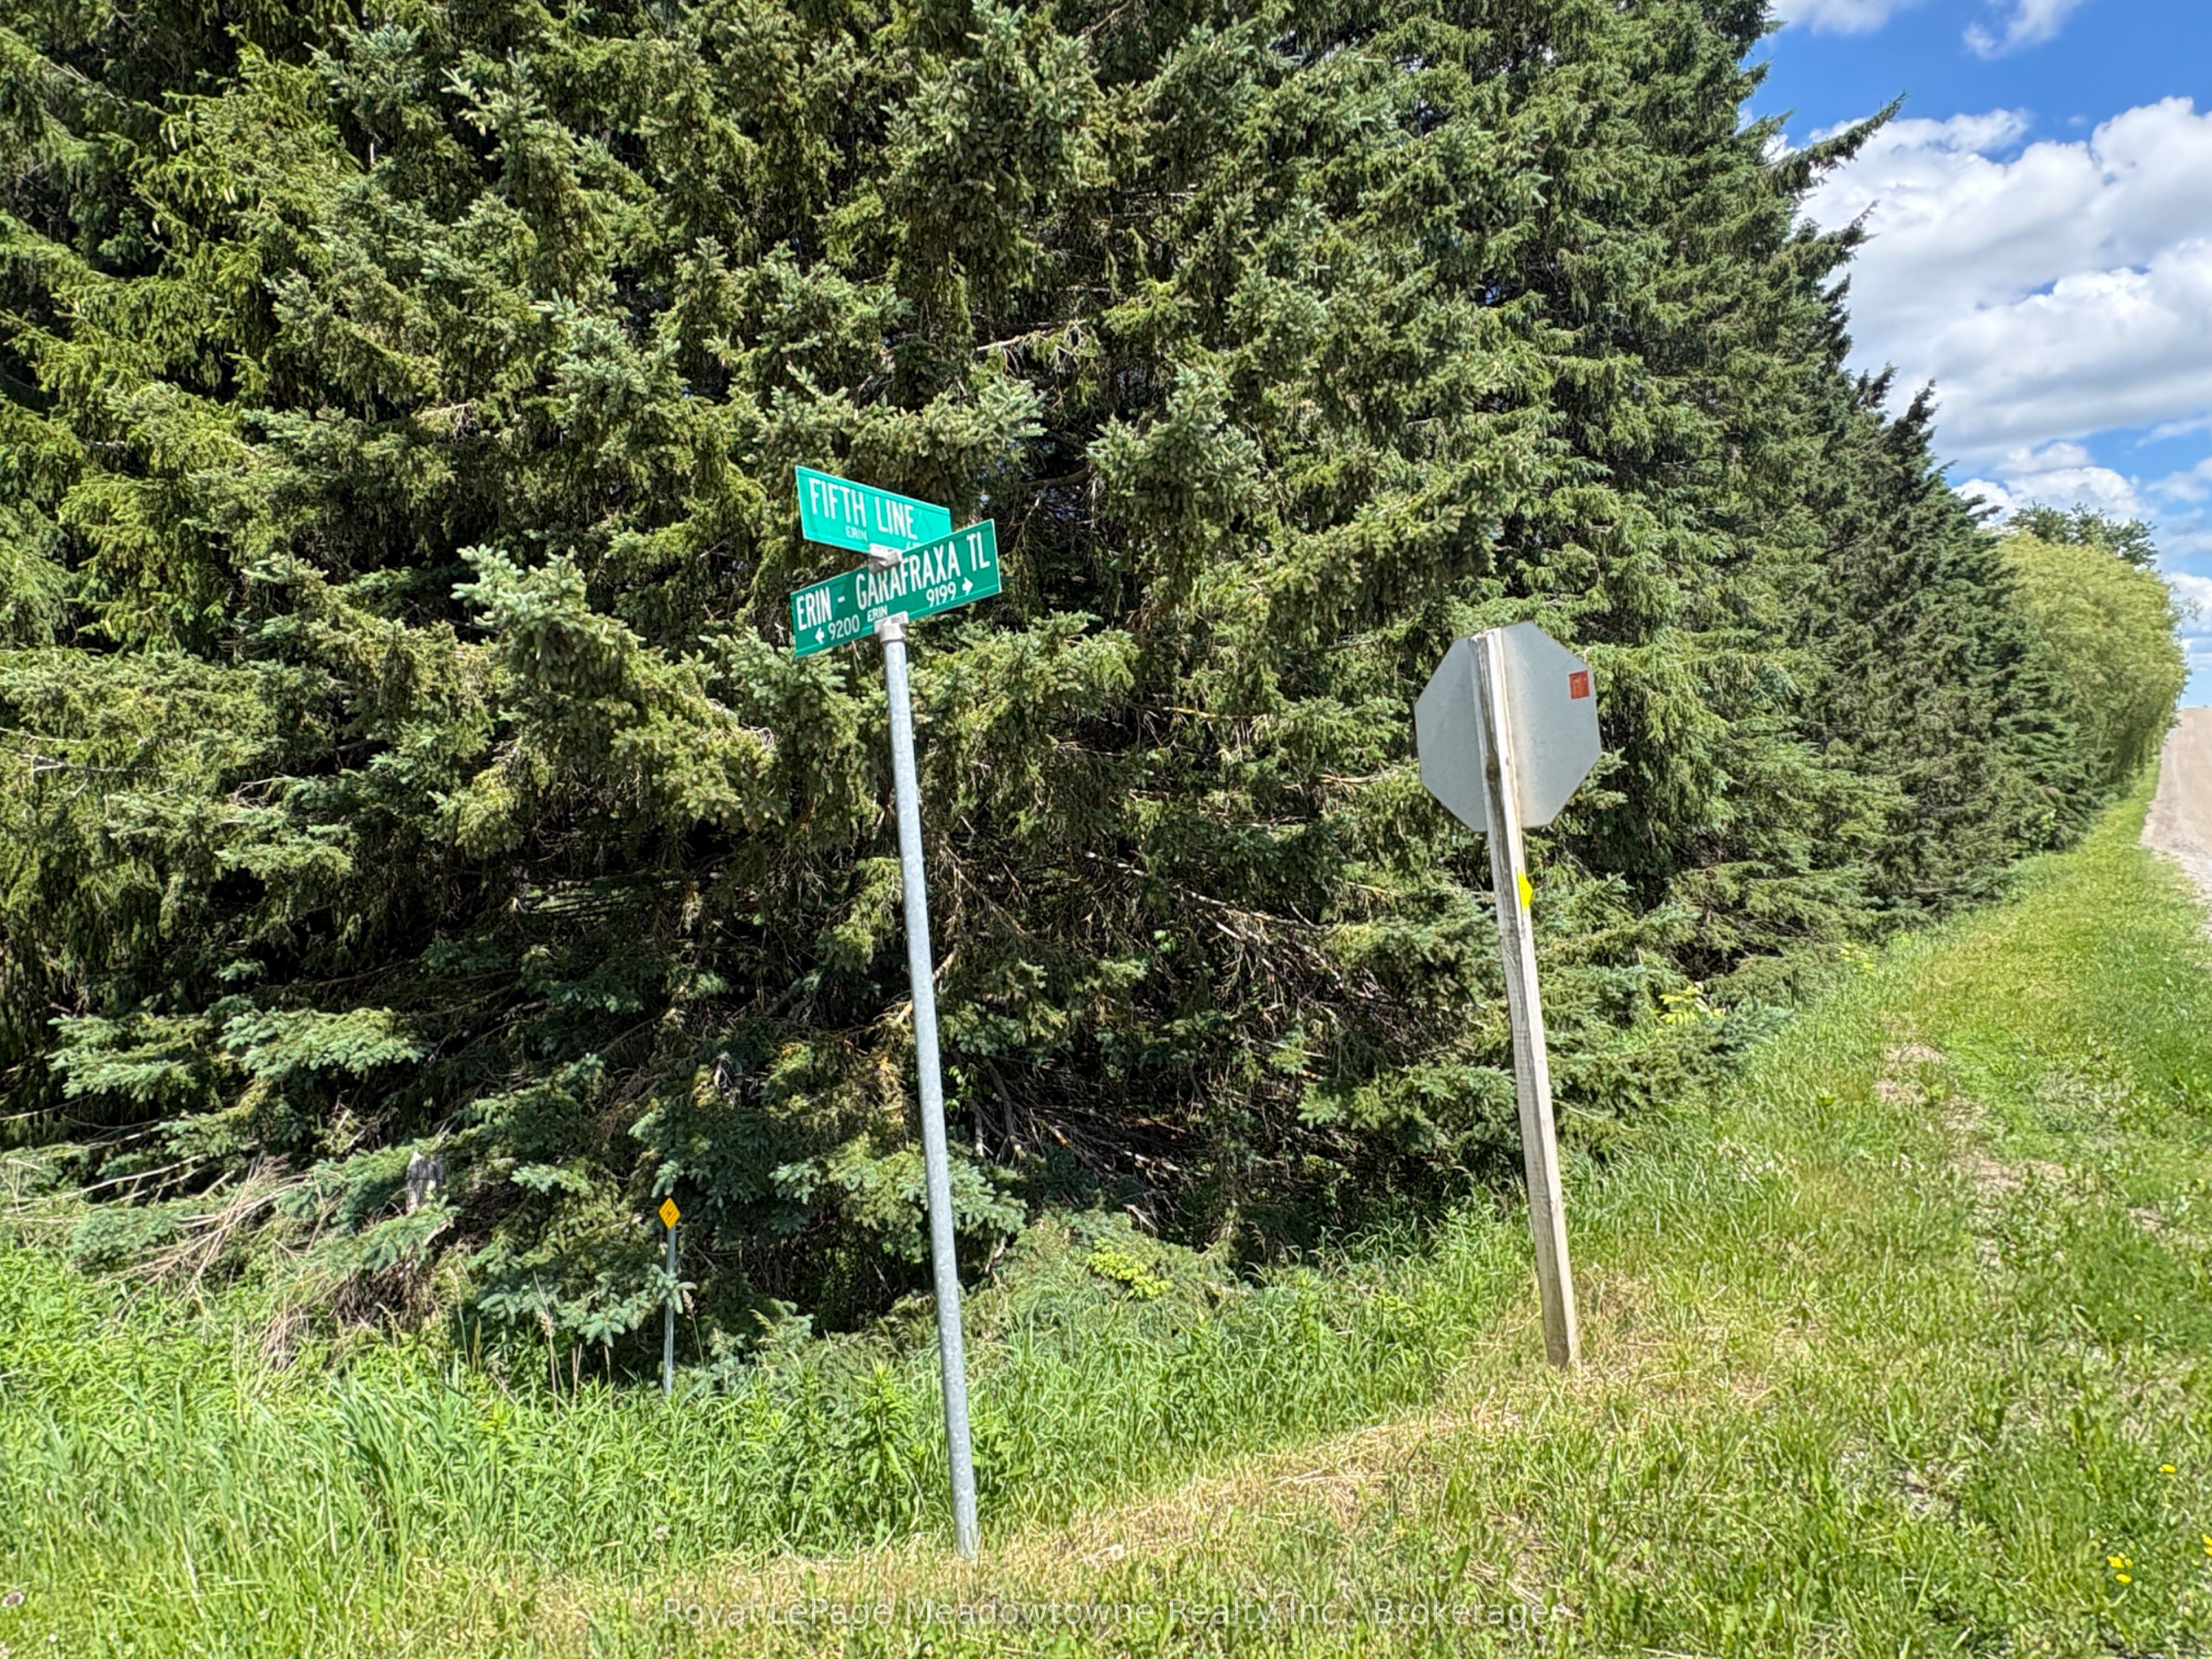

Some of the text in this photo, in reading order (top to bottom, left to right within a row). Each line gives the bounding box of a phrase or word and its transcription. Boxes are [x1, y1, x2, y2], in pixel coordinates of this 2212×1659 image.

[808, 477, 918, 540] FIFTH LINE
[845, 525, 867, 541] ERIN
[796, 586, 832, 631] ERIN
[855, 540, 961, 611] GARAFRAXA
[967, 531, 991, 572] TL
[925, 581, 957, 608] 9199
[866, 604, 888, 623] ERIN
[828, 615, 860, 641] 9200
